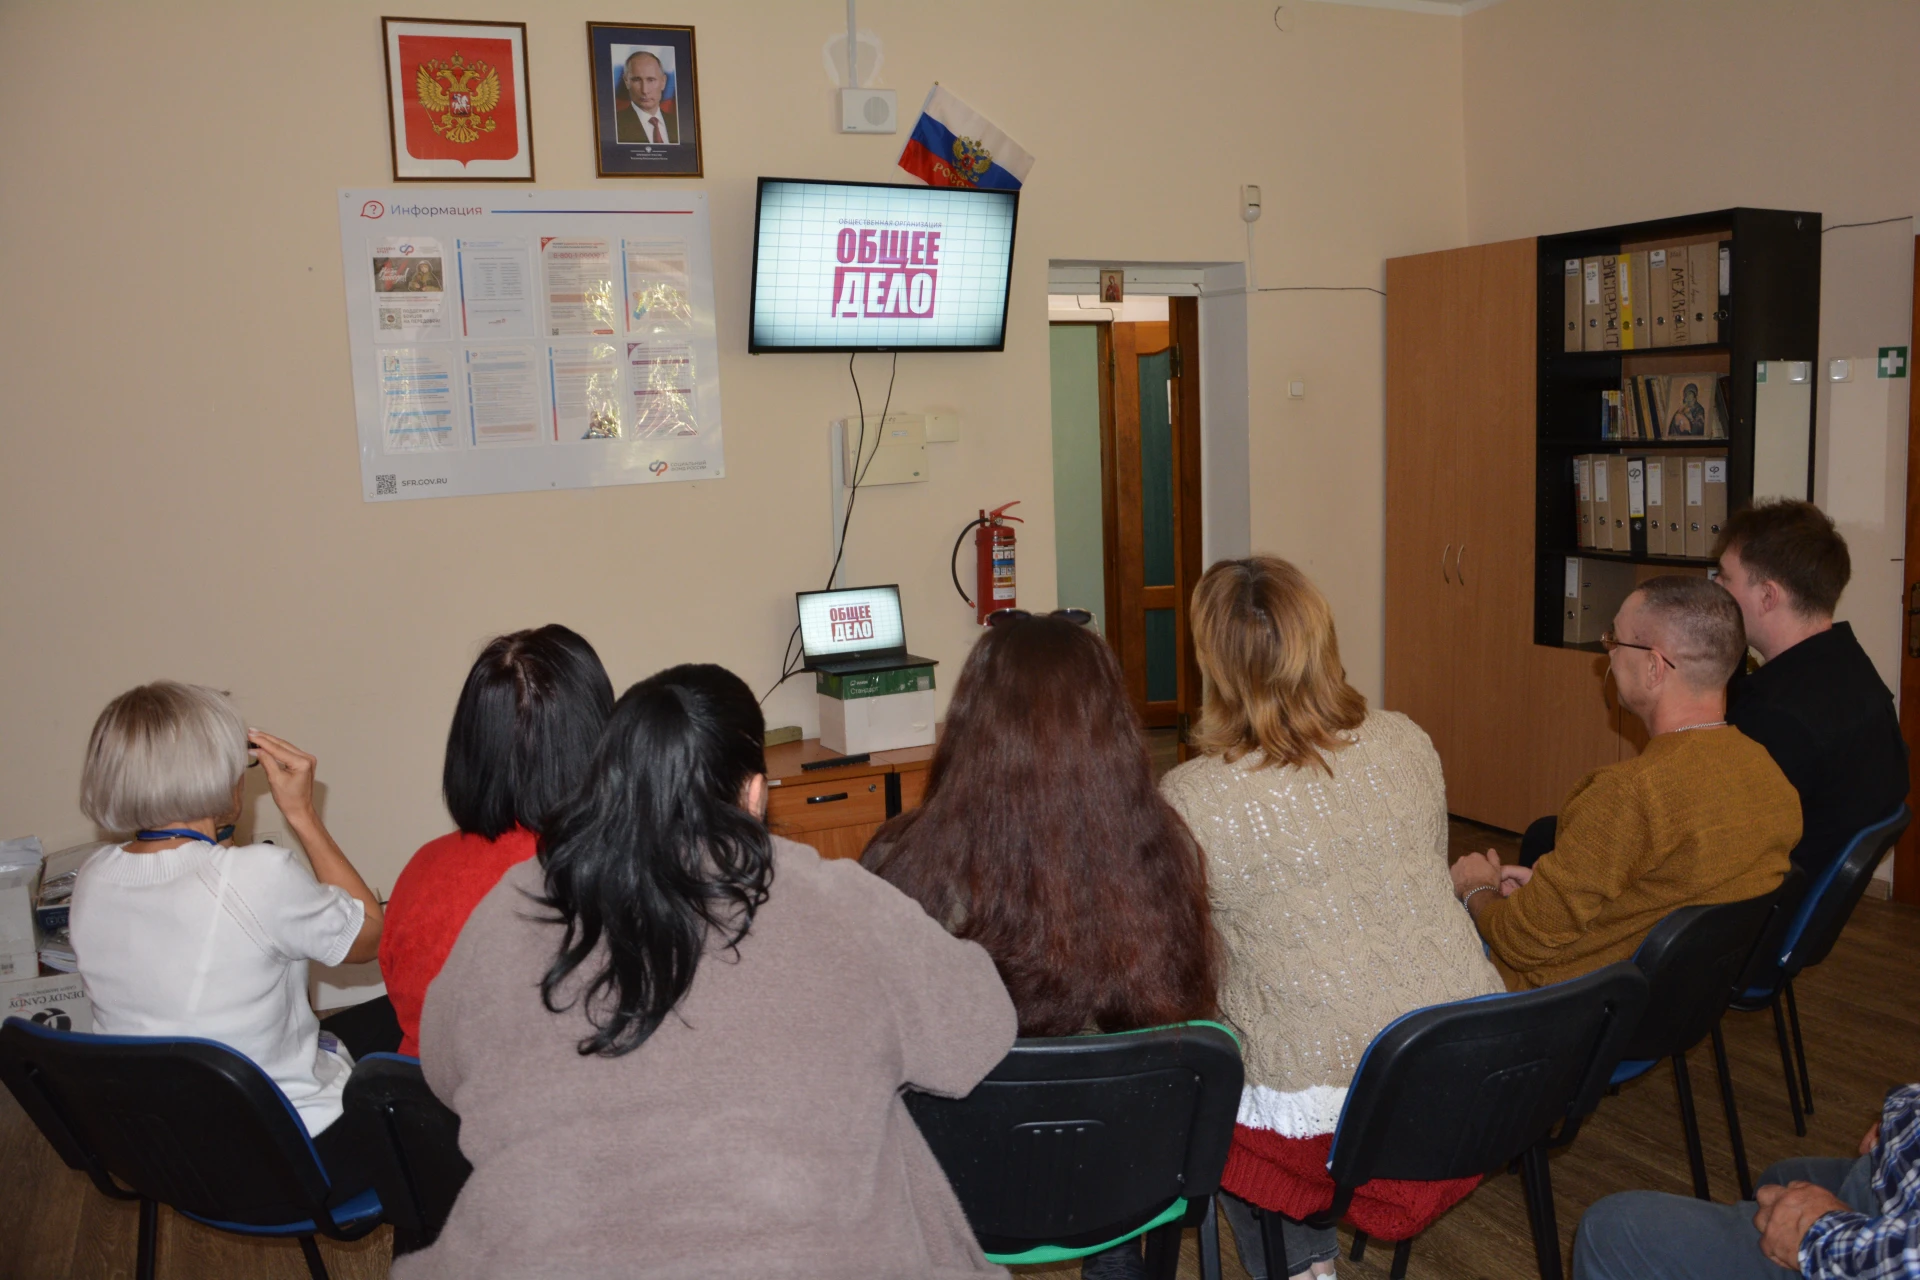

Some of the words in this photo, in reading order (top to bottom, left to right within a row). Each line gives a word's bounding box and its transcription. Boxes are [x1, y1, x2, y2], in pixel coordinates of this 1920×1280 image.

[390, 204, 482, 218] Информация
[838, 218, 893, 227] ОБЩЕСТВЕННАЯ
[894, 220, 942, 228] ОРГАНИЗАЦИЯ
[836, 227, 941, 268] ОБЩЕЕ
[834, 270, 935, 318] ДЕЛО
[670, 460, 707, 468] СОЦИАЛЬНЫЙ
[401, 477, 448, 487] SFR.GOV.RU
[829, 606, 872, 621] ОБЩЕЕ
[832, 620, 873, 641] ДЕЛО
[9, 996, 46, 1009] CANDY
[48, 990, 85, 1003] DENDY
